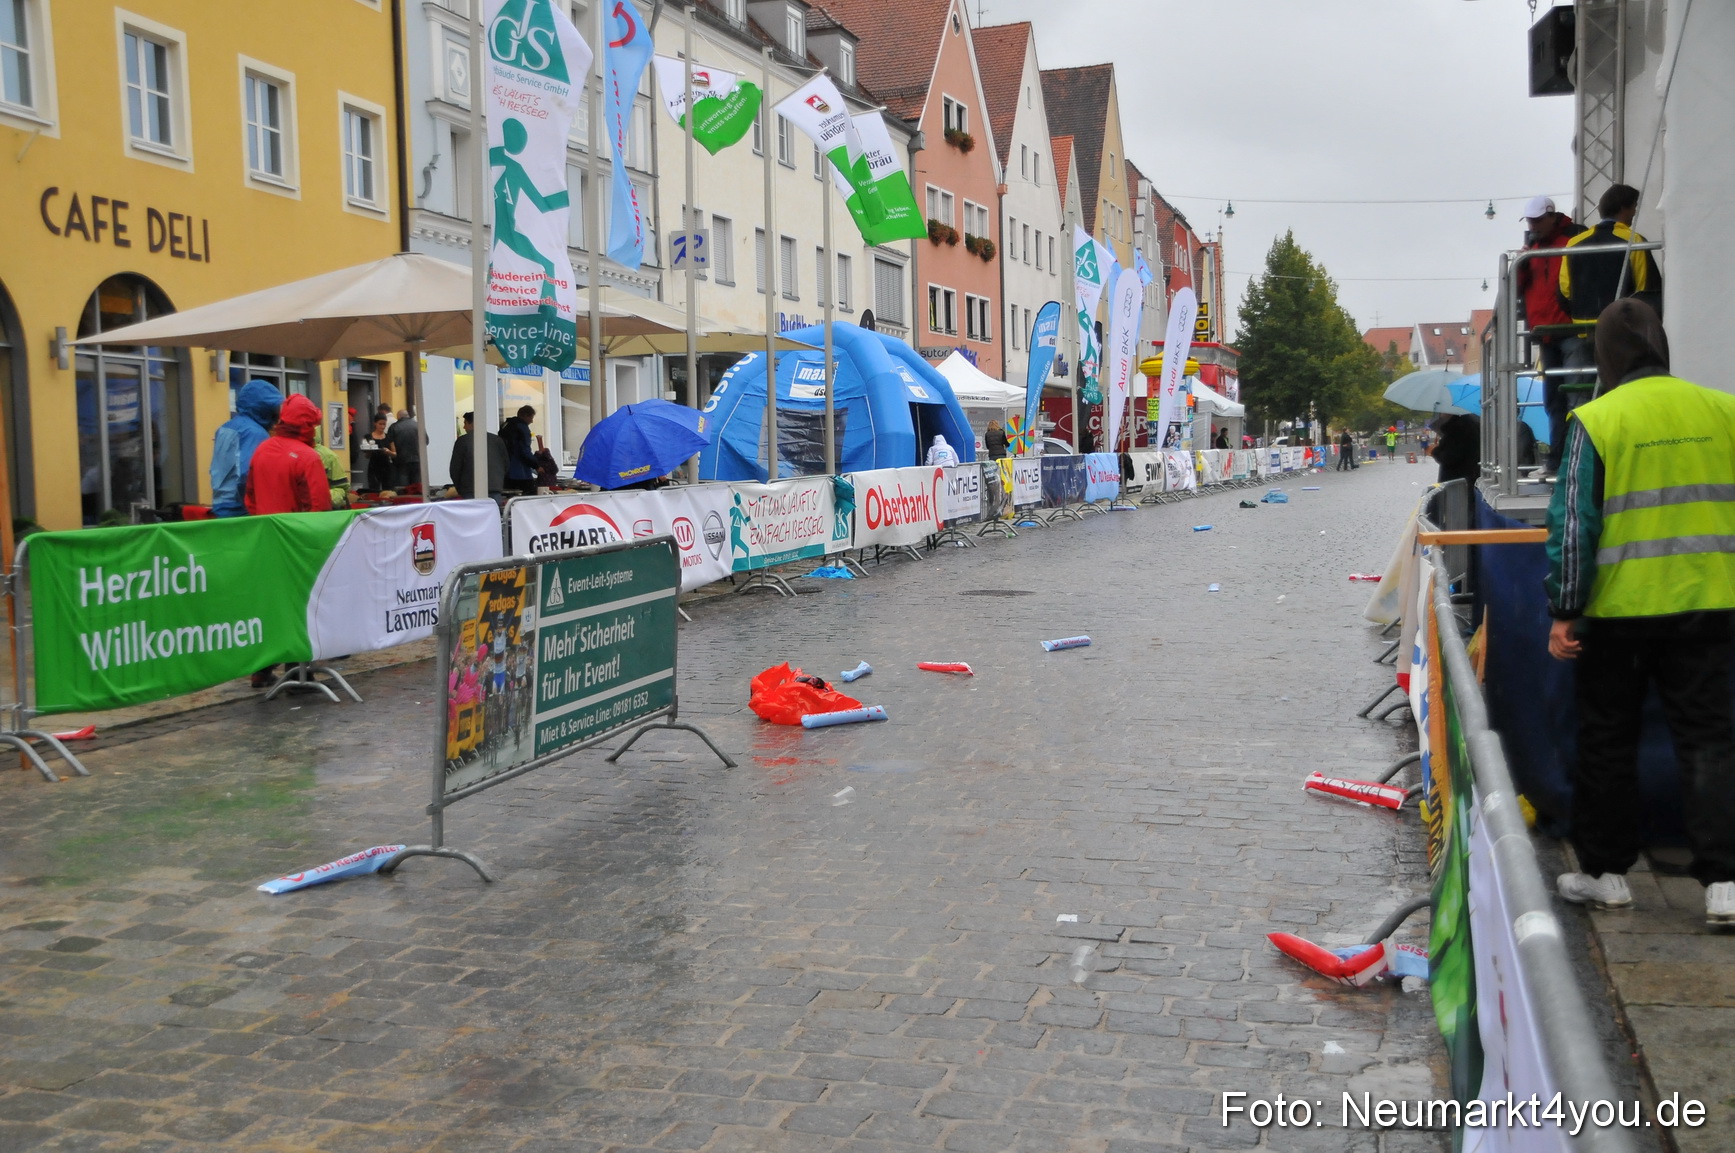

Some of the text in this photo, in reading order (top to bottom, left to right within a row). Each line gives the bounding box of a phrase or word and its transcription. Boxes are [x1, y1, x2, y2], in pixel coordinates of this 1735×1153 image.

[494, 66, 569, 97] bäude Service GmbH
[700, 102, 733, 131] antwortung
[868, 155, 893, 170] bräu
[40, 186, 211, 264] CAFE DELI
[1195, 303, 1208, 342] HOT
[1117, 326, 1130, 392] Audi BKK
[1167, 340, 1182, 397] Audi BKK
[865, 483, 931, 530] Oberbank
[529, 527, 607, 553] GERHART
[674, 526, 693, 544] KIA
[750, 516, 825, 546] EINFACH BESSER
[682, 554, 702, 568] MOTORS
[80, 554, 207, 607] Herzlich
[396, 582, 443, 605] Neumark
[568, 569, 634, 594] Event-Leit-Systeme
[489, 594, 516, 614] erdgas
[385, 606, 440, 634] Lamms
[81, 617, 263, 671] Willkommen
[543, 630, 577, 663] Mehr
[580, 614, 635, 653] Sicherheit
[542, 653, 621, 701] für Ihr Event!
[540, 690, 649, 746] Miet & Service Line: 09181 6352
